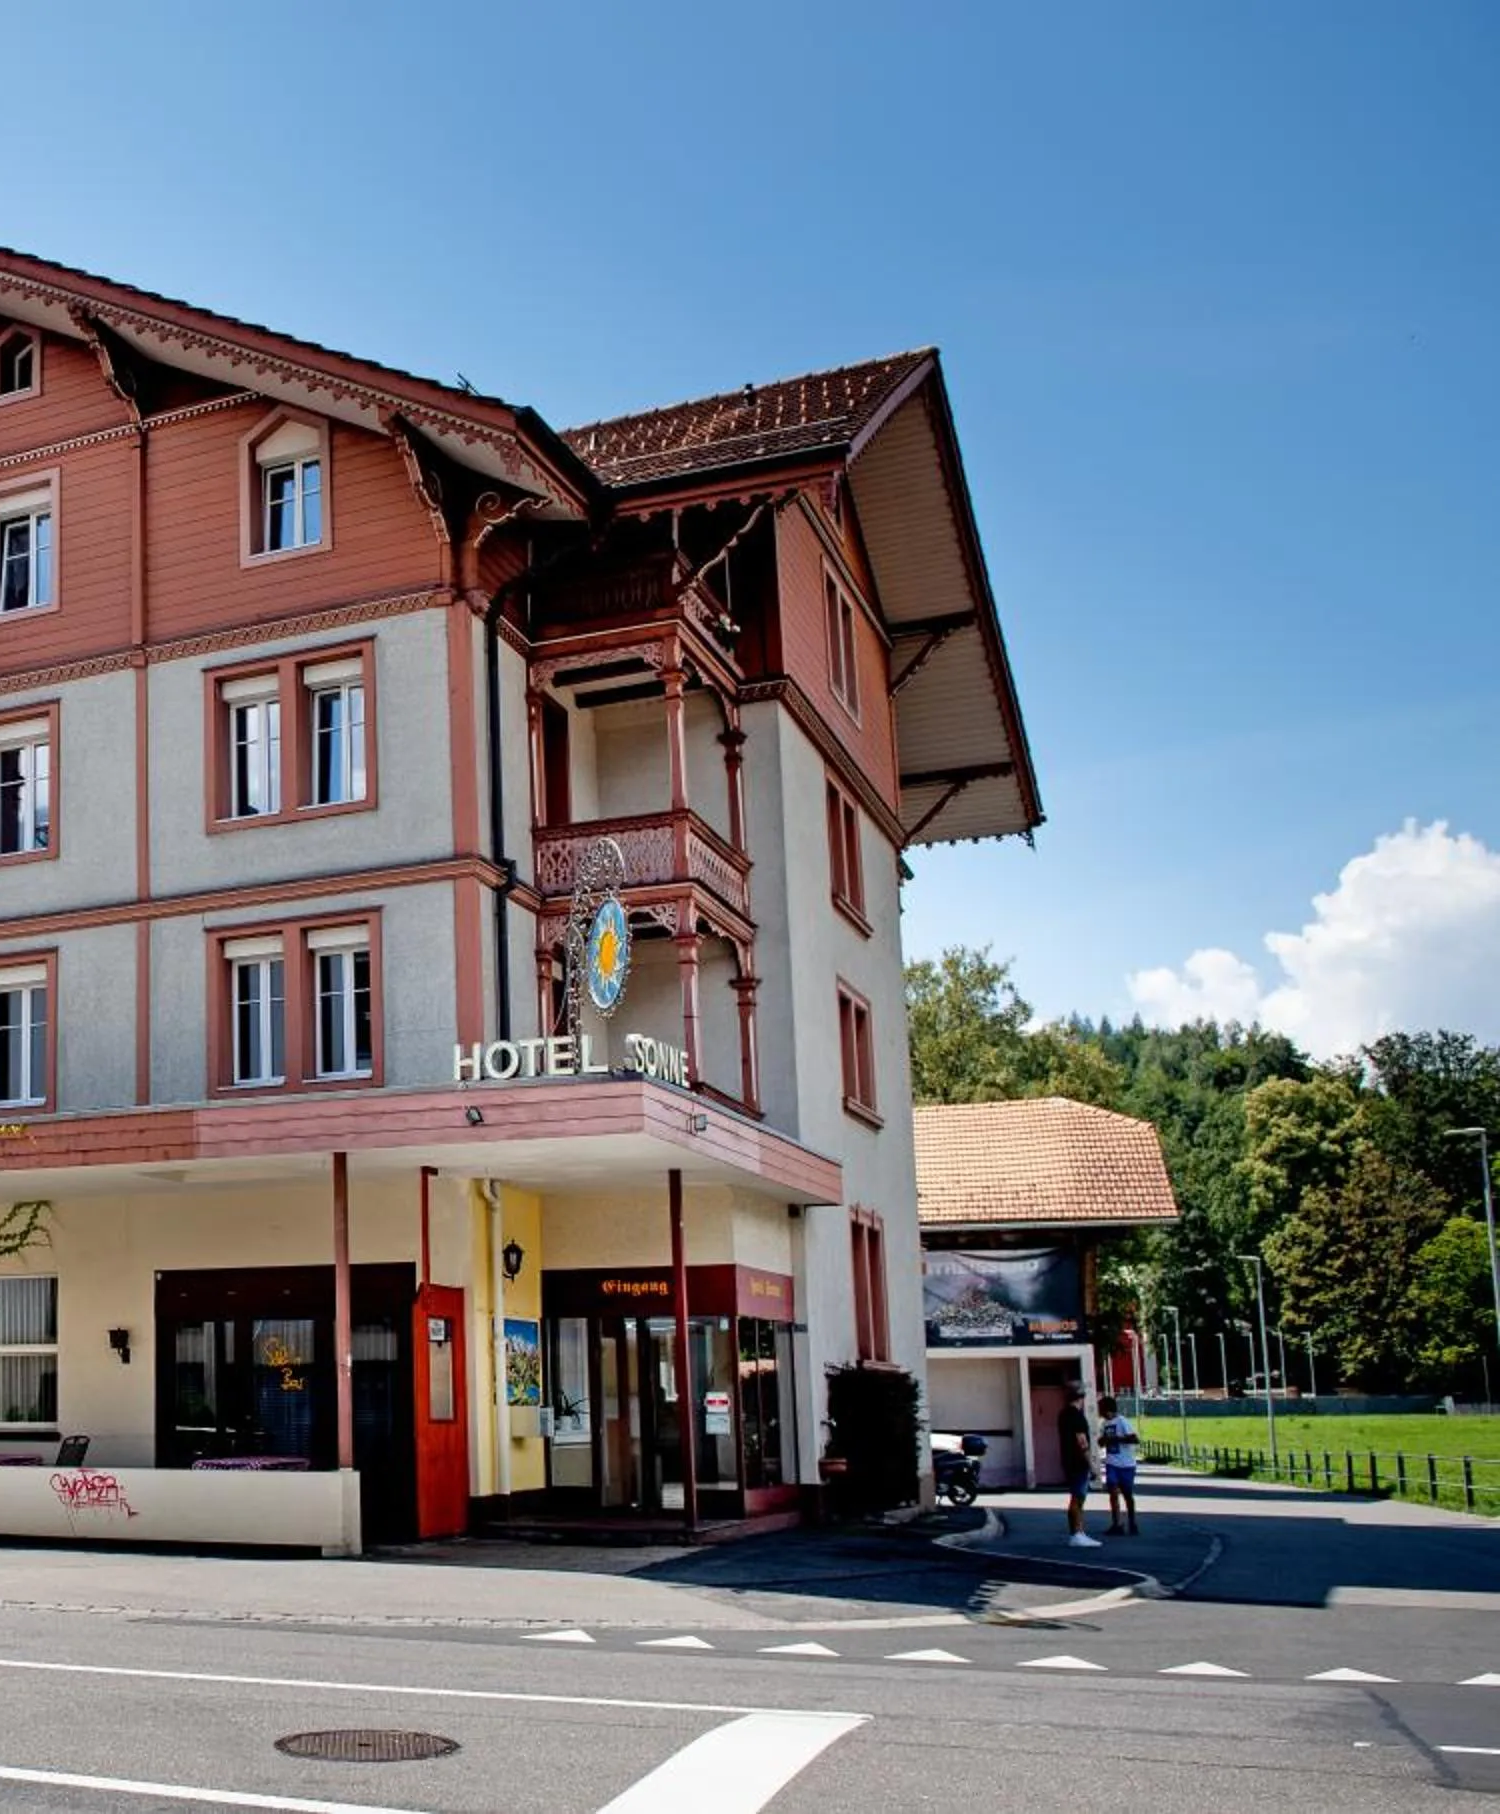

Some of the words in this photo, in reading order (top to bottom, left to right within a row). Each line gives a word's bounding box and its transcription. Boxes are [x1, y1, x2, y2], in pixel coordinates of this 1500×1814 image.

[452, 1034, 608, 1081] HOTEL
[628, 1033, 690, 1088] SONNE
[602, 1279, 669, 1296] Eingang
